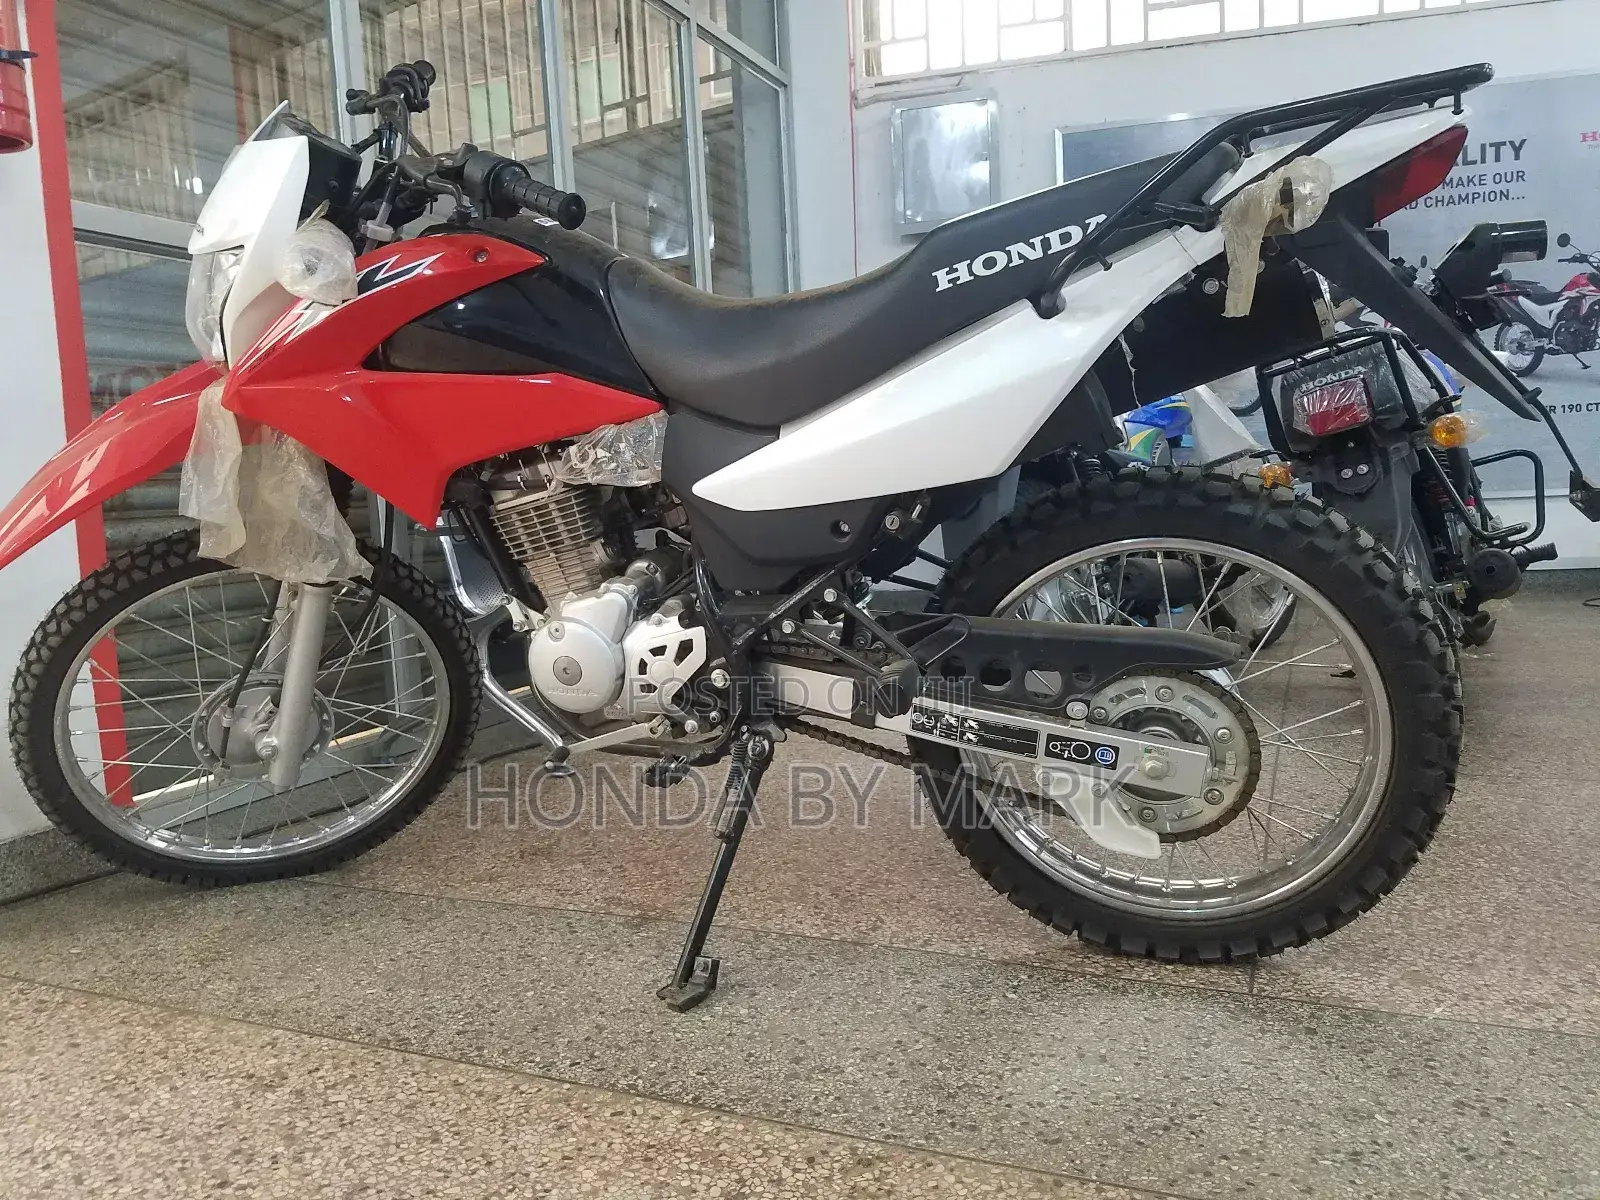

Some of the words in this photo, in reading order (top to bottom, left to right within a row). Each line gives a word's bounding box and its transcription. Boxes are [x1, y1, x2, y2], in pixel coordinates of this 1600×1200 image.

[1454, 139, 1527, 167] LITY
[1442, 174, 1488, 189] MAKE
[1492, 170, 1526, 184] OUR
[1424, 189, 1525, 208] CHAMPION...
[1300, 366, 1368, 392] HONDA
[1561, 403, 1582, 414] 190
